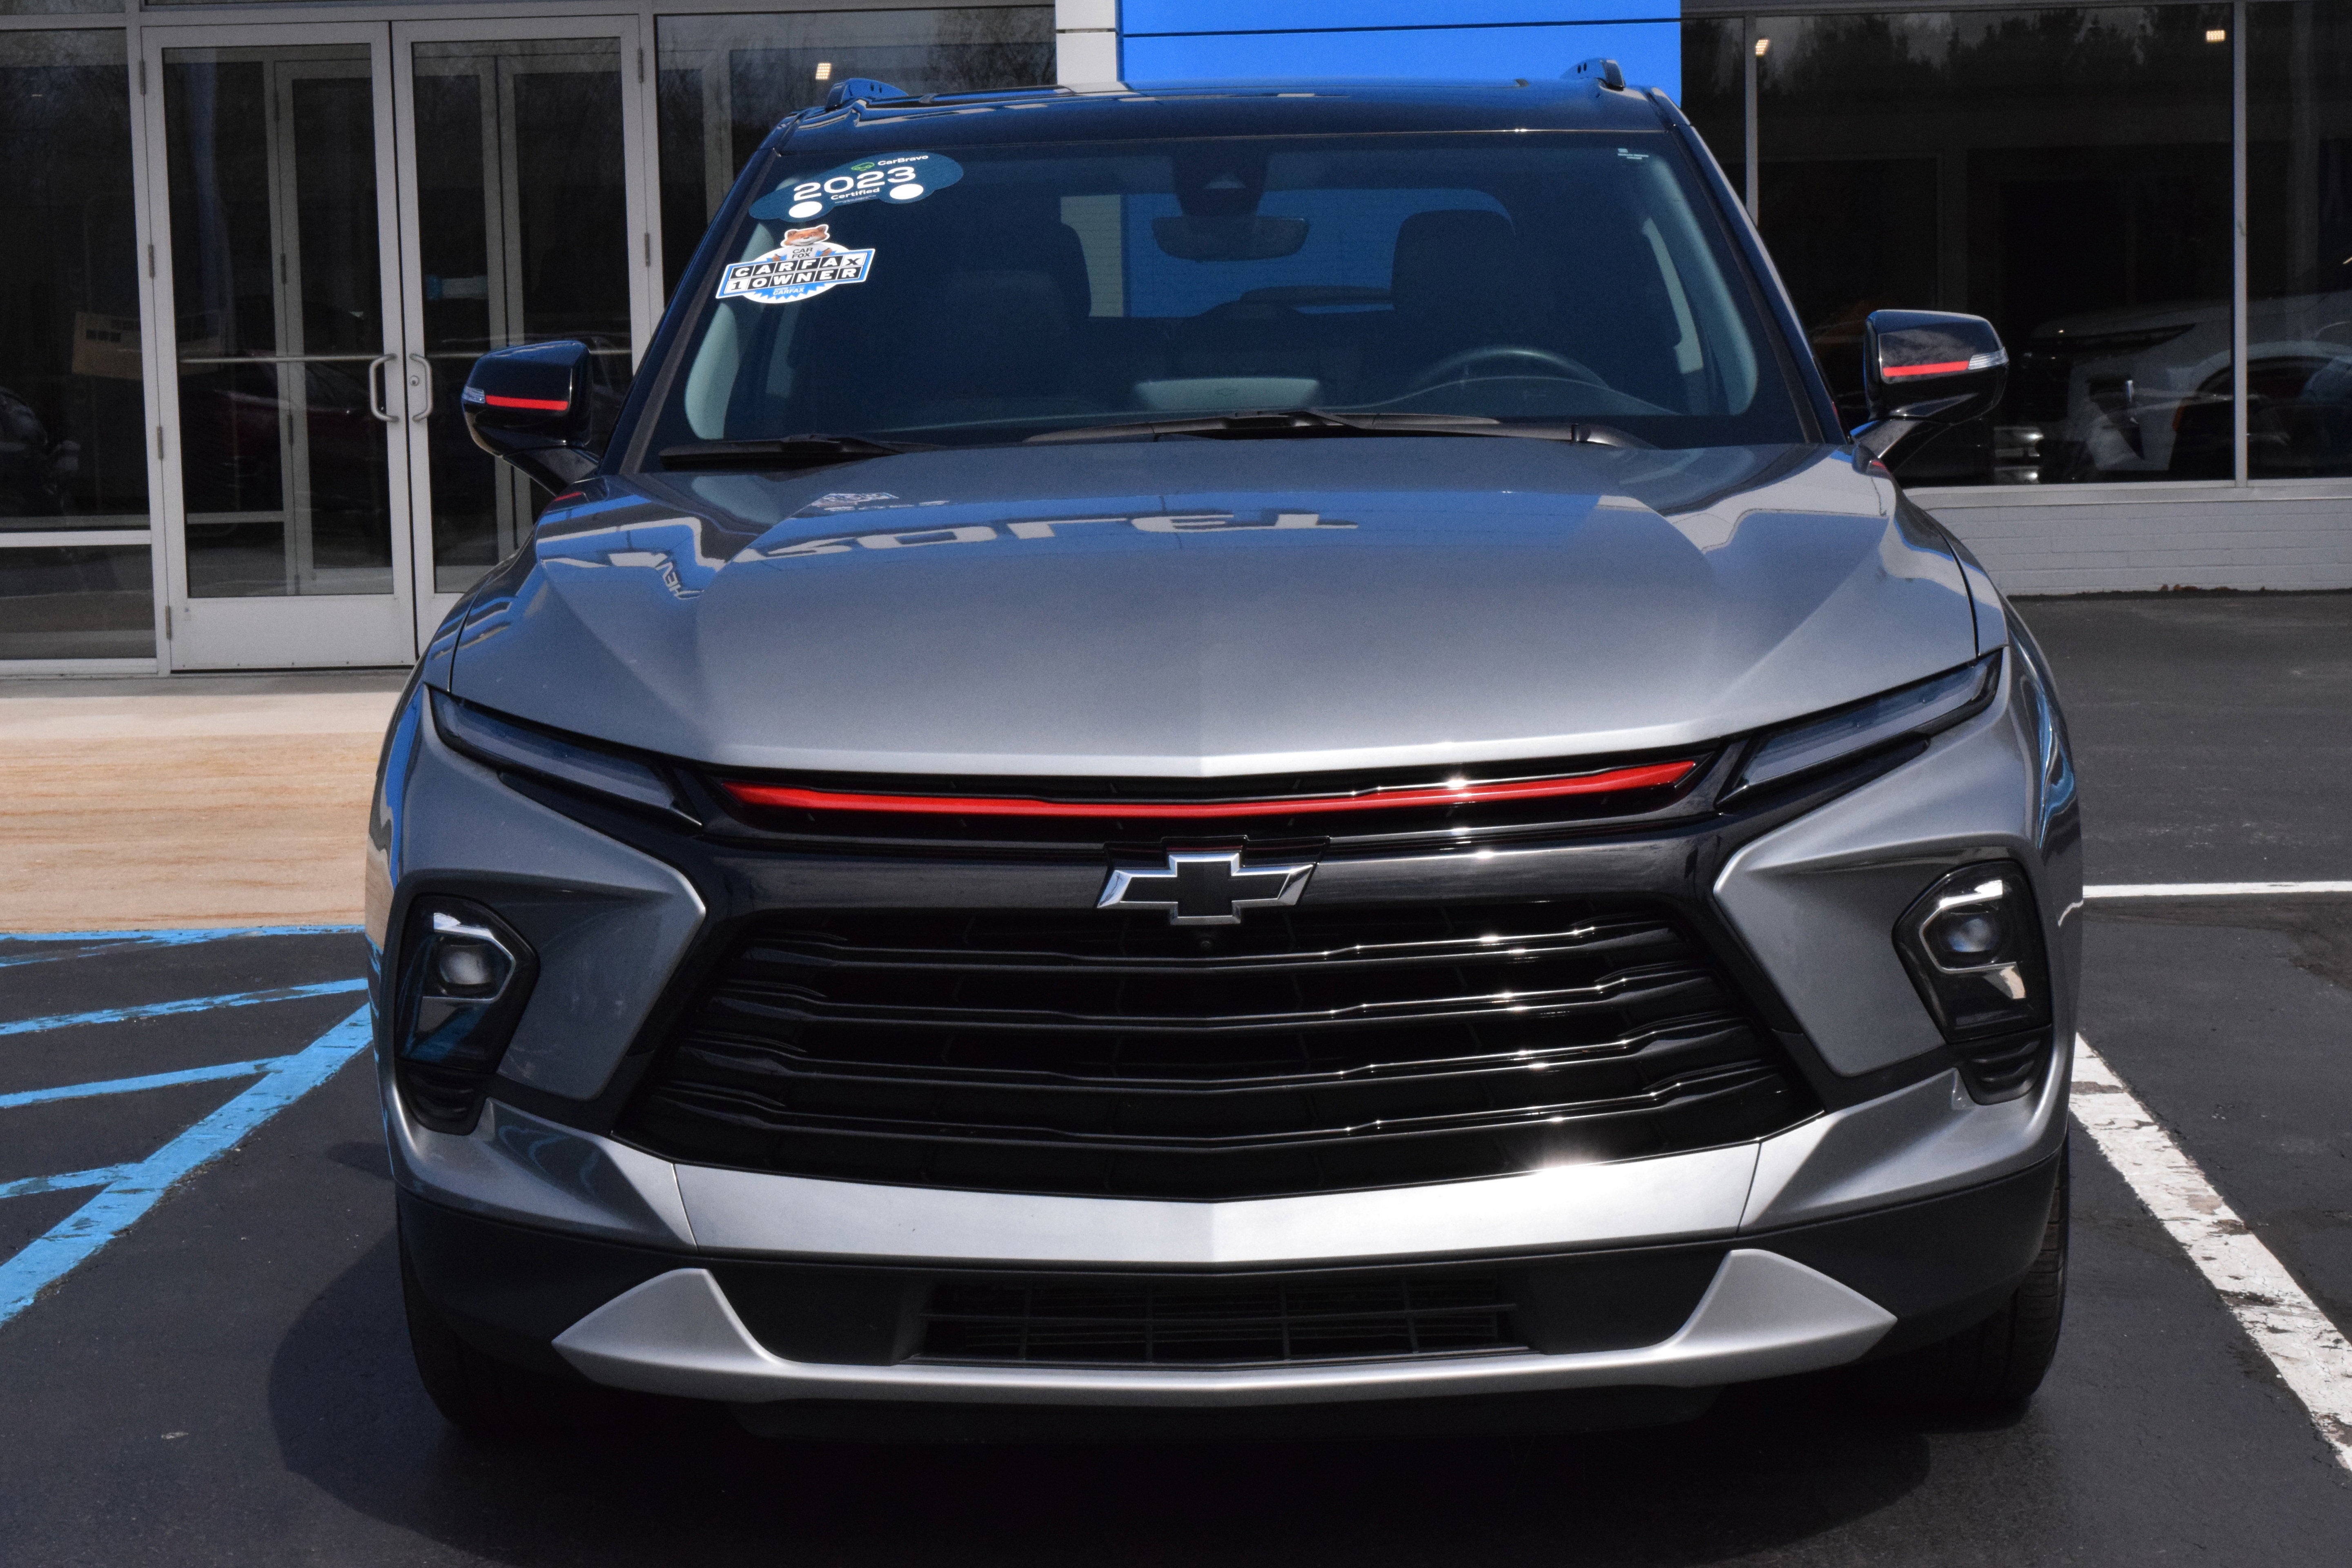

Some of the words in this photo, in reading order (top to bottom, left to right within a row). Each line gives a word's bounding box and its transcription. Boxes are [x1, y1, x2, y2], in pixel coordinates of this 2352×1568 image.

[878, 155, 929, 165] CarBravo
[793, 167, 916, 201] 2023
[831, 187, 880, 200] Certified
[735, 257, 860, 277] CARFAX
[731, 281, 745, 291] 1
[752, 268, 857, 288] OWNER
